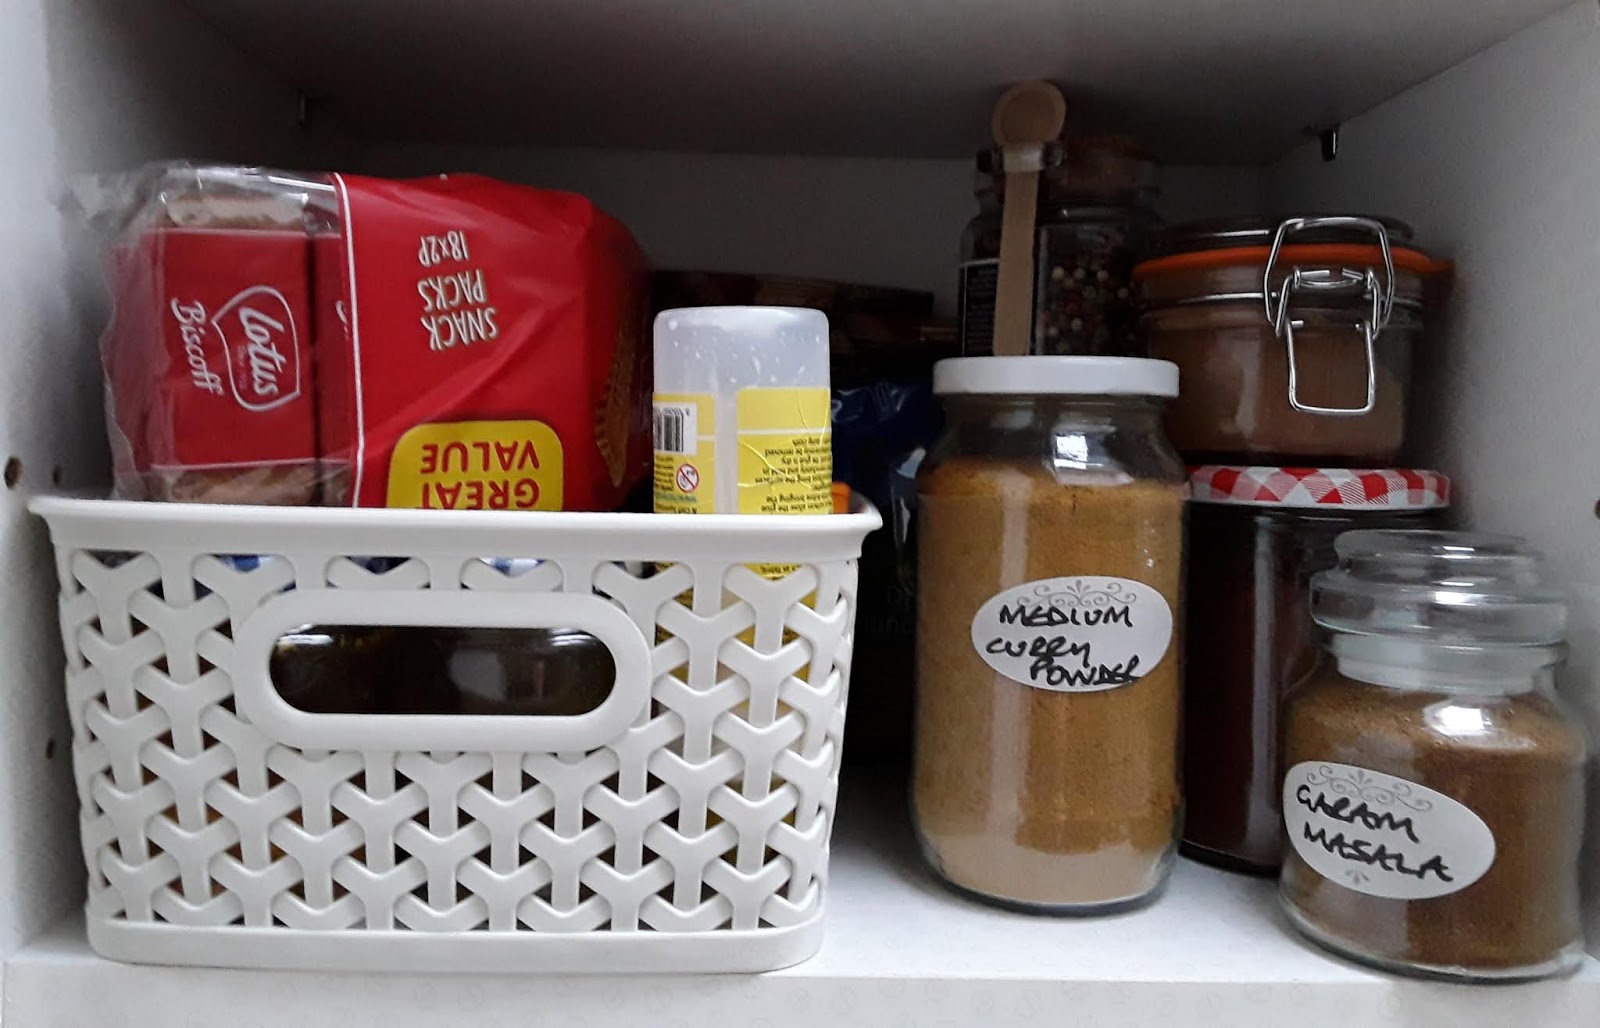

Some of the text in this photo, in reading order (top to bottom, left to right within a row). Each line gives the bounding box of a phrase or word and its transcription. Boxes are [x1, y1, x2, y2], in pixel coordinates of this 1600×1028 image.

[418, 230, 470, 267] 18x2P
[417, 269, 486, 313] PACKS
[171, 298, 224, 396] Biscoff
[238, 306, 287, 396] Lotus
[420, 307, 498, 351] SNACK
[420, 439, 540, 474] VALUE
[416, 477, 540, 510] GREAT
[999, 604, 1133, 627] MEDIUM
[1030, 654, 1142, 686] POWDER
[1296, 784, 1420, 843] GARAM
[1303, 821, 1454, 882] MASALA
